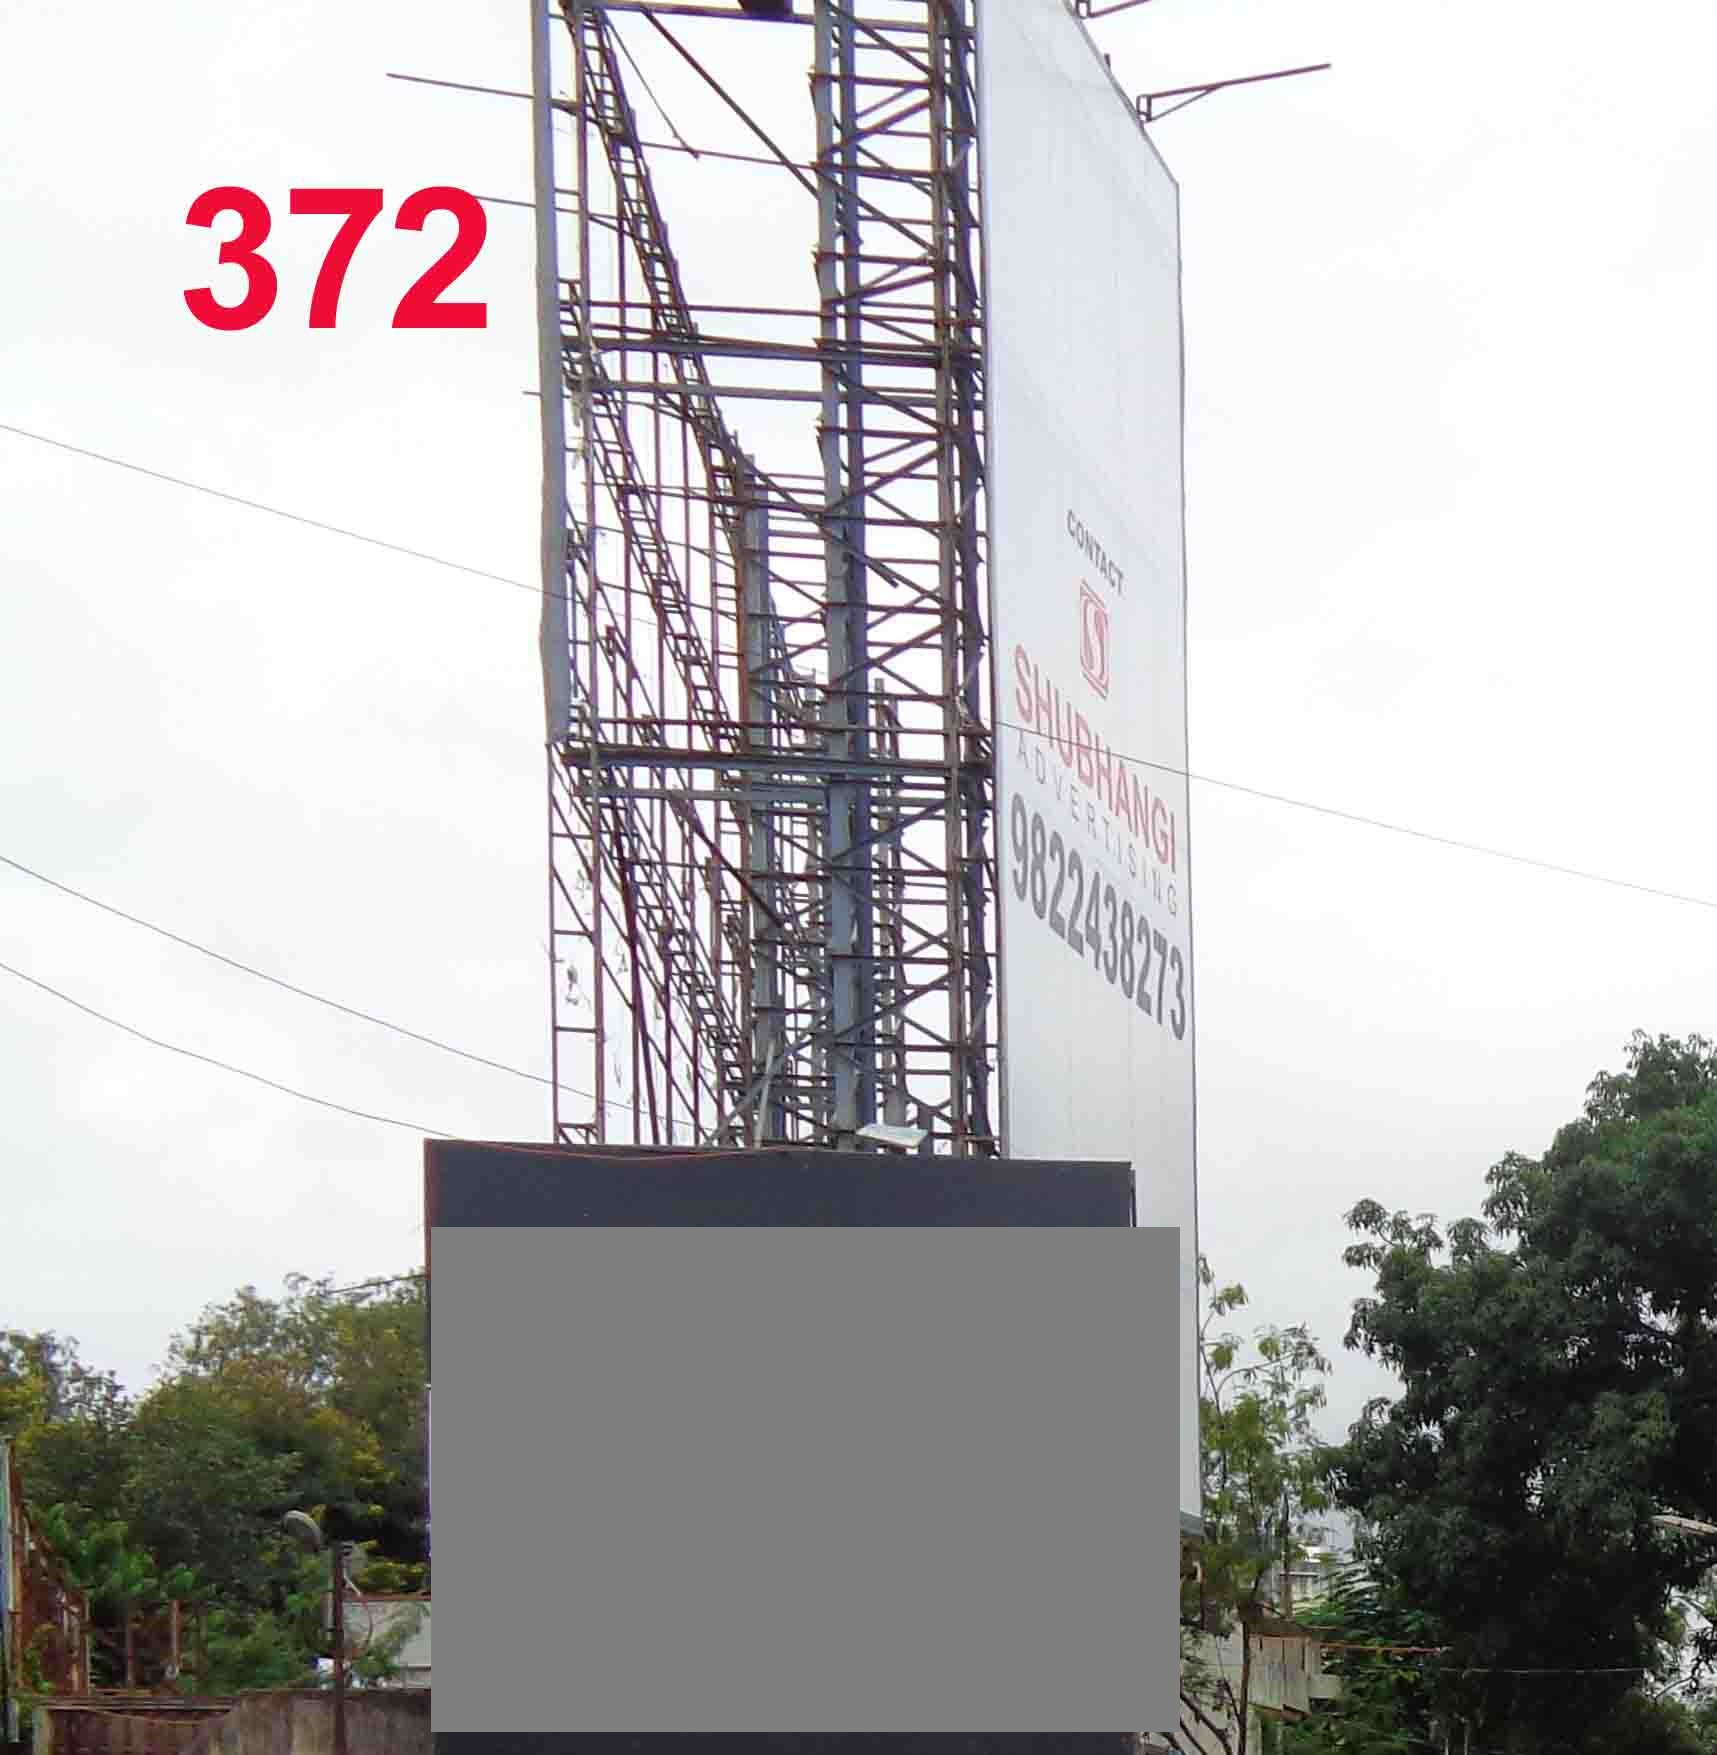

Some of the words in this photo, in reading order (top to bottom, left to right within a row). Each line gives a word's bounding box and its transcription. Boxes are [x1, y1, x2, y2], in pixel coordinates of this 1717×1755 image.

[1066, 509, 1124, 595] CONTACT
[1015, 643, 1177, 873] SHUBHANGI
[1017, 730, 1177, 916] ADVERTISING
[1011, 792, 1187, 1041] 9822438273
